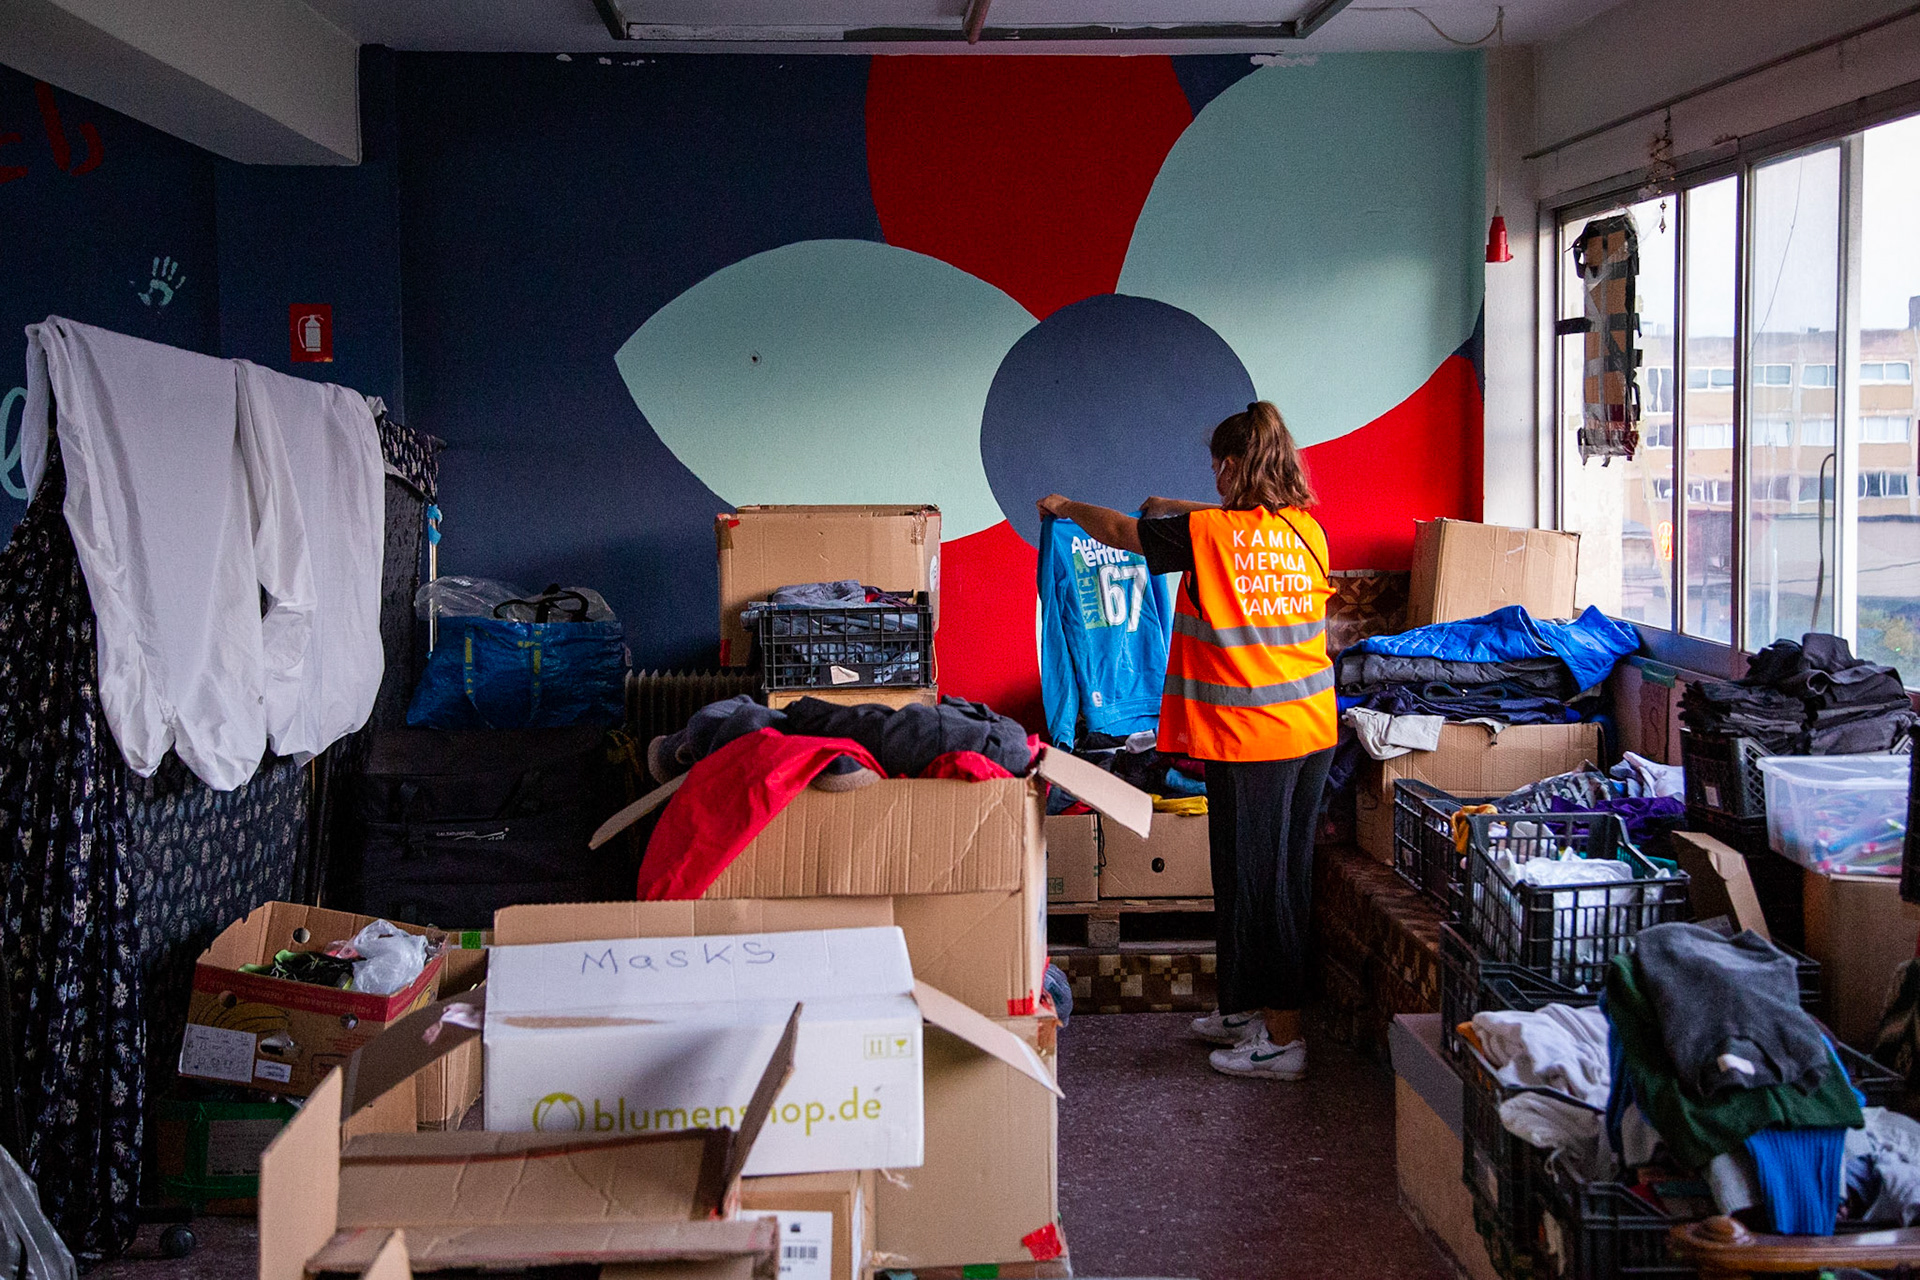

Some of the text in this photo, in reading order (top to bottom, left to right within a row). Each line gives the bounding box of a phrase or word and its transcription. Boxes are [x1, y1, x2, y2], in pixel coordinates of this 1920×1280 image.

[1235, 552, 1306, 572] ΜΕΡΙΔΑ
[1076, 568, 1100, 623] SINCE
[1099, 564, 1148, 633] 67
[1235, 574, 1313, 594] ΦΑΓΗΤΟΥ
